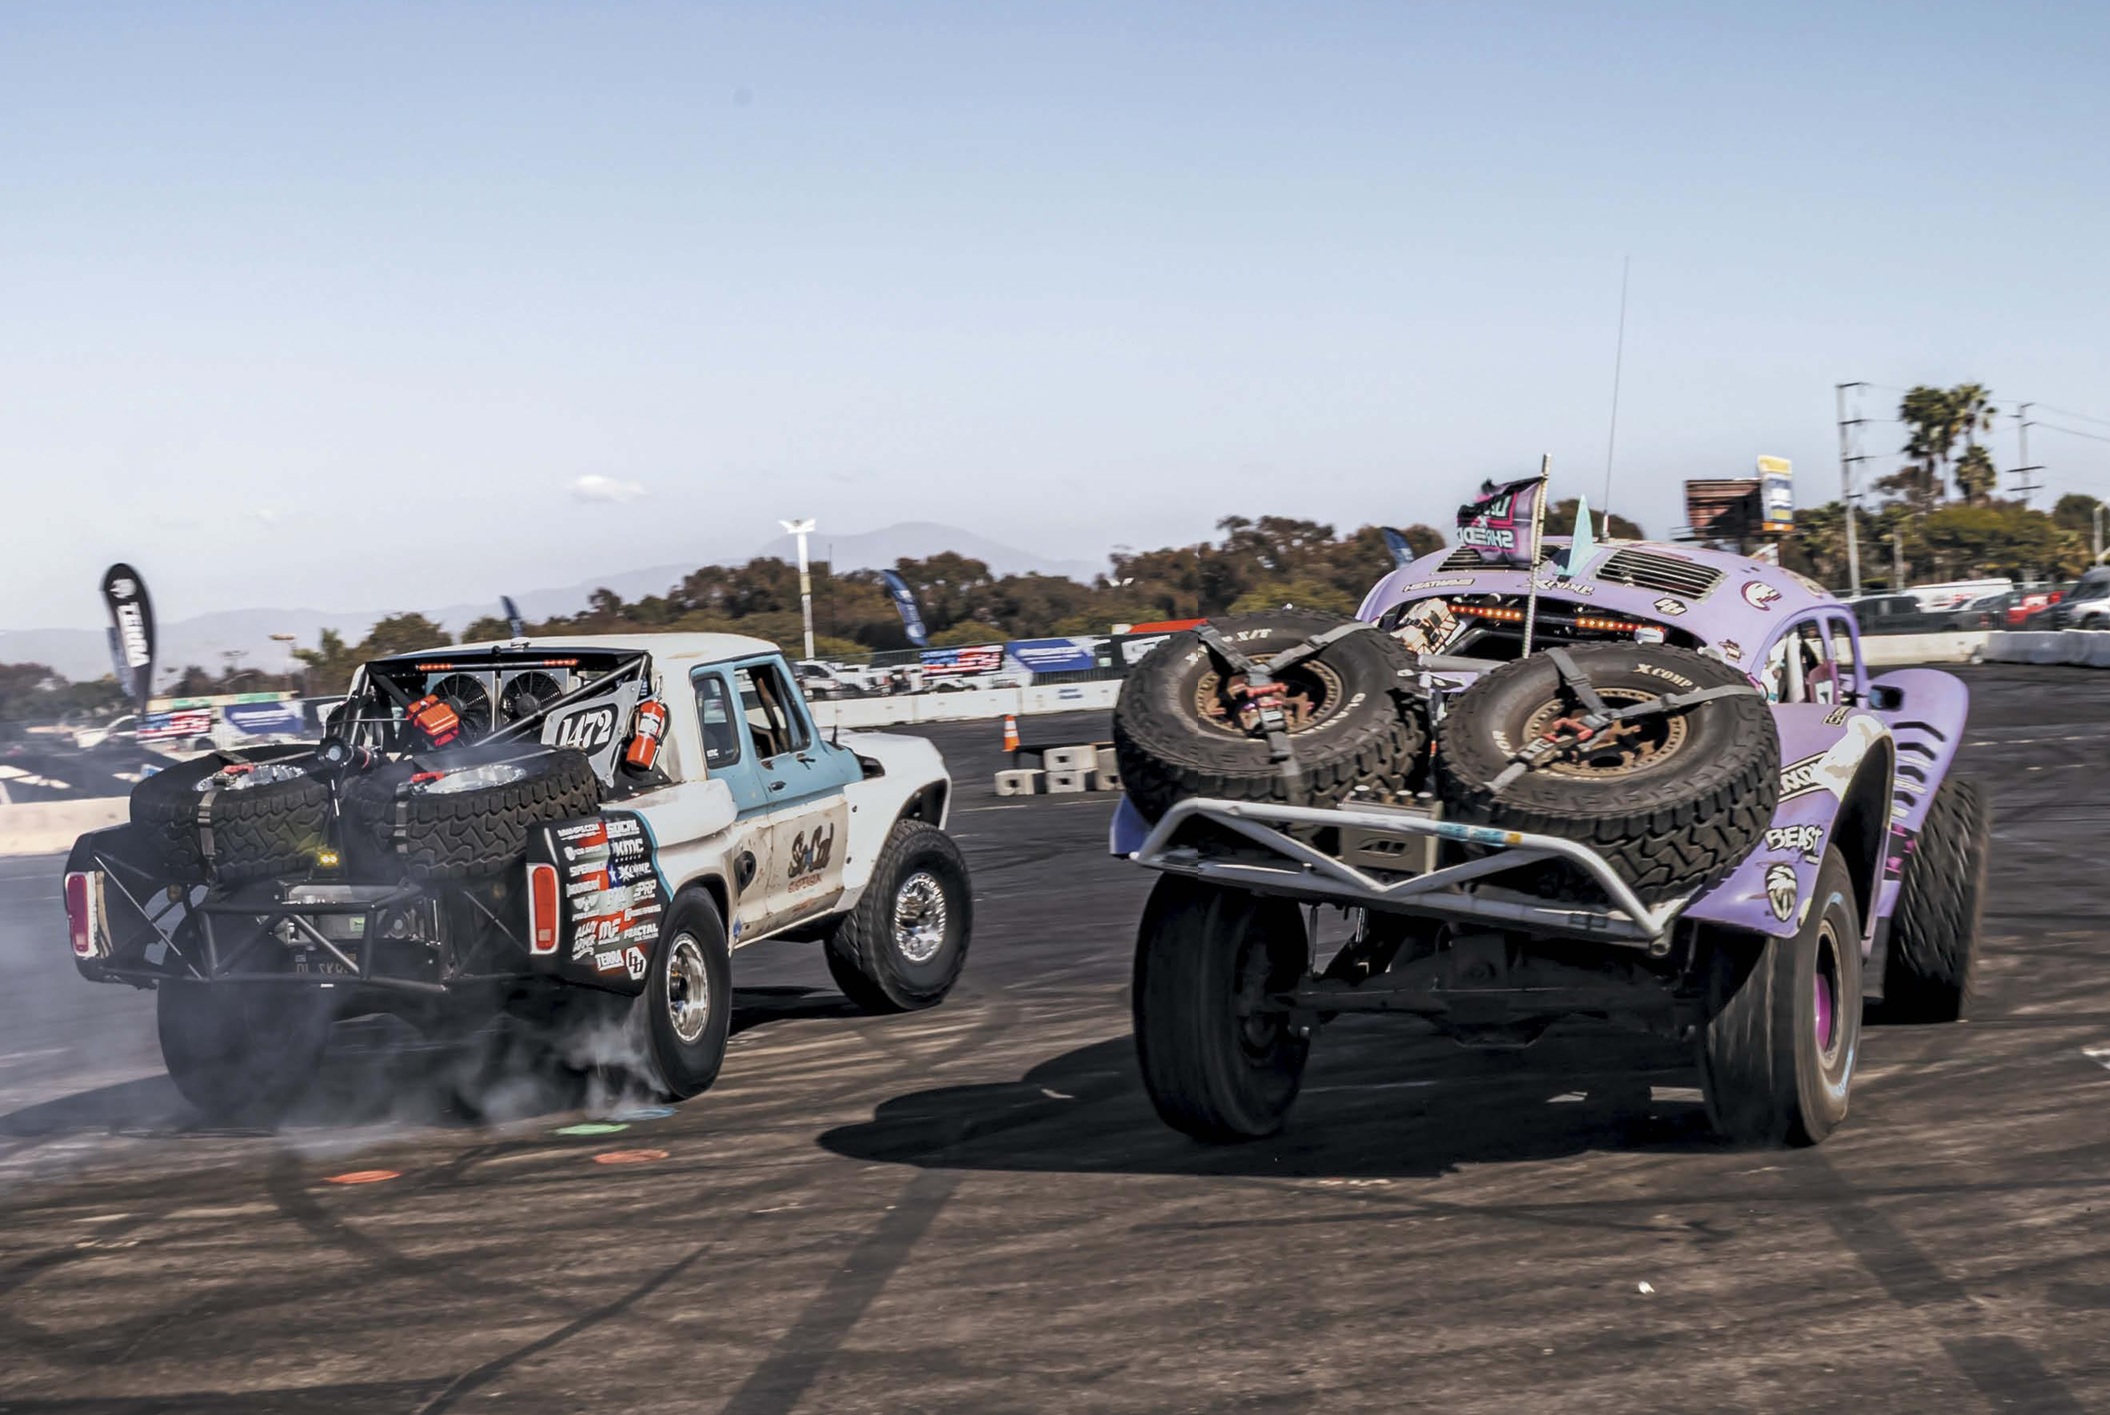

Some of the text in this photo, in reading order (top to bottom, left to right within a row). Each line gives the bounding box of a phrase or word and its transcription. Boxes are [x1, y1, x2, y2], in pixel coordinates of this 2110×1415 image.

[1651, 667, 1694, 687] COMP
[561, 709, 612, 748] 1472
[612, 839, 644, 856] KMC
[1764, 824, 1824, 851] BEAST
